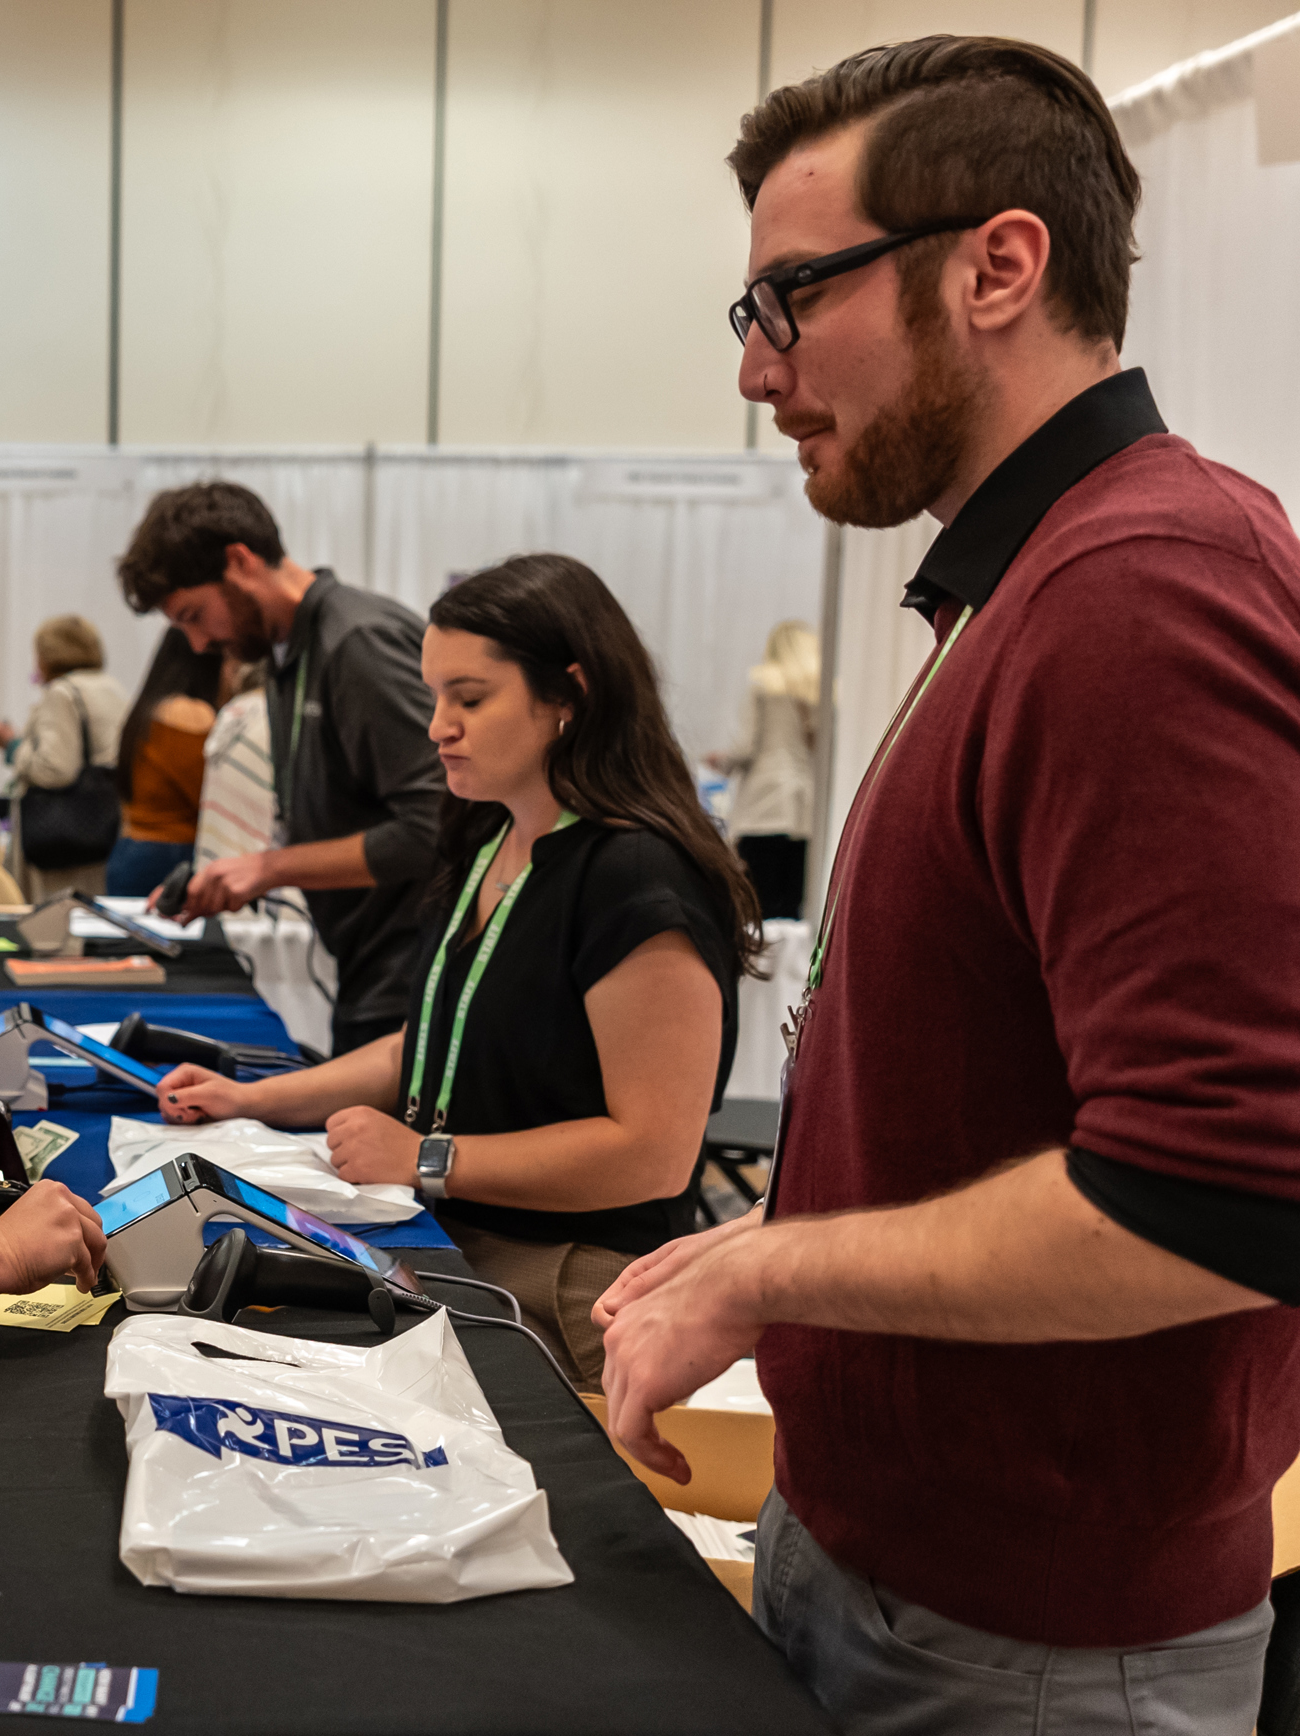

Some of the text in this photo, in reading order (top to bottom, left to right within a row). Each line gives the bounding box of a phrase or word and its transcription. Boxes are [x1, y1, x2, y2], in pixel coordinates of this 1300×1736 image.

[478, 924, 500, 962] STAFF
[457, 981, 475, 1019] STAFF
[445, 1039, 459, 1077] STAFF
